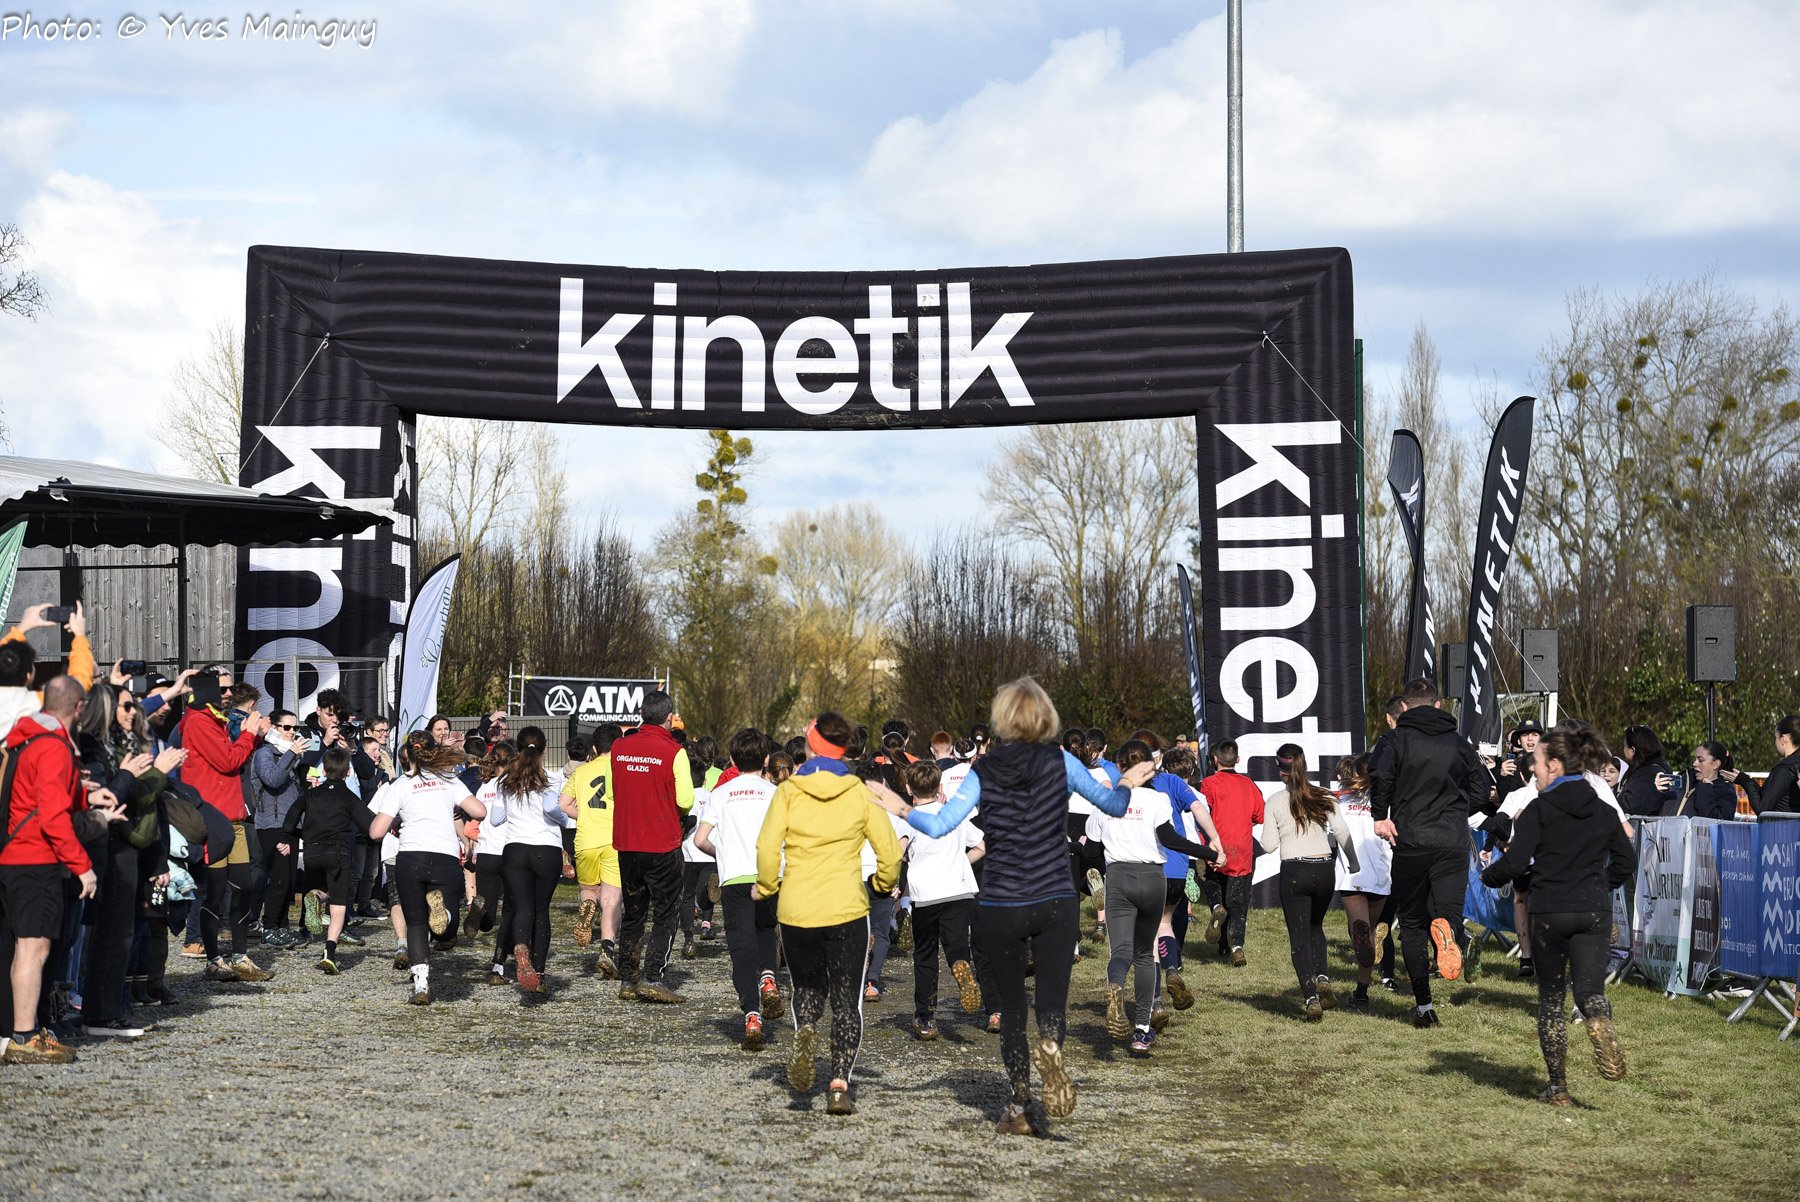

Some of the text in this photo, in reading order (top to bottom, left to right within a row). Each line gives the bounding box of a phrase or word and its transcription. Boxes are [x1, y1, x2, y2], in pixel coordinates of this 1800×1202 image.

[556, 276, 1036, 415] kinetik
[1213, 420, 1352, 886] kinet
[578, 685, 645, 714] ATM
[578, 713, 642, 722] COMMUNICATIO
[616, 754, 663, 766] ORGANISATION
[626, 765, 650, 773] GLAZIG
[729, 789, 755, 798] SUPER
